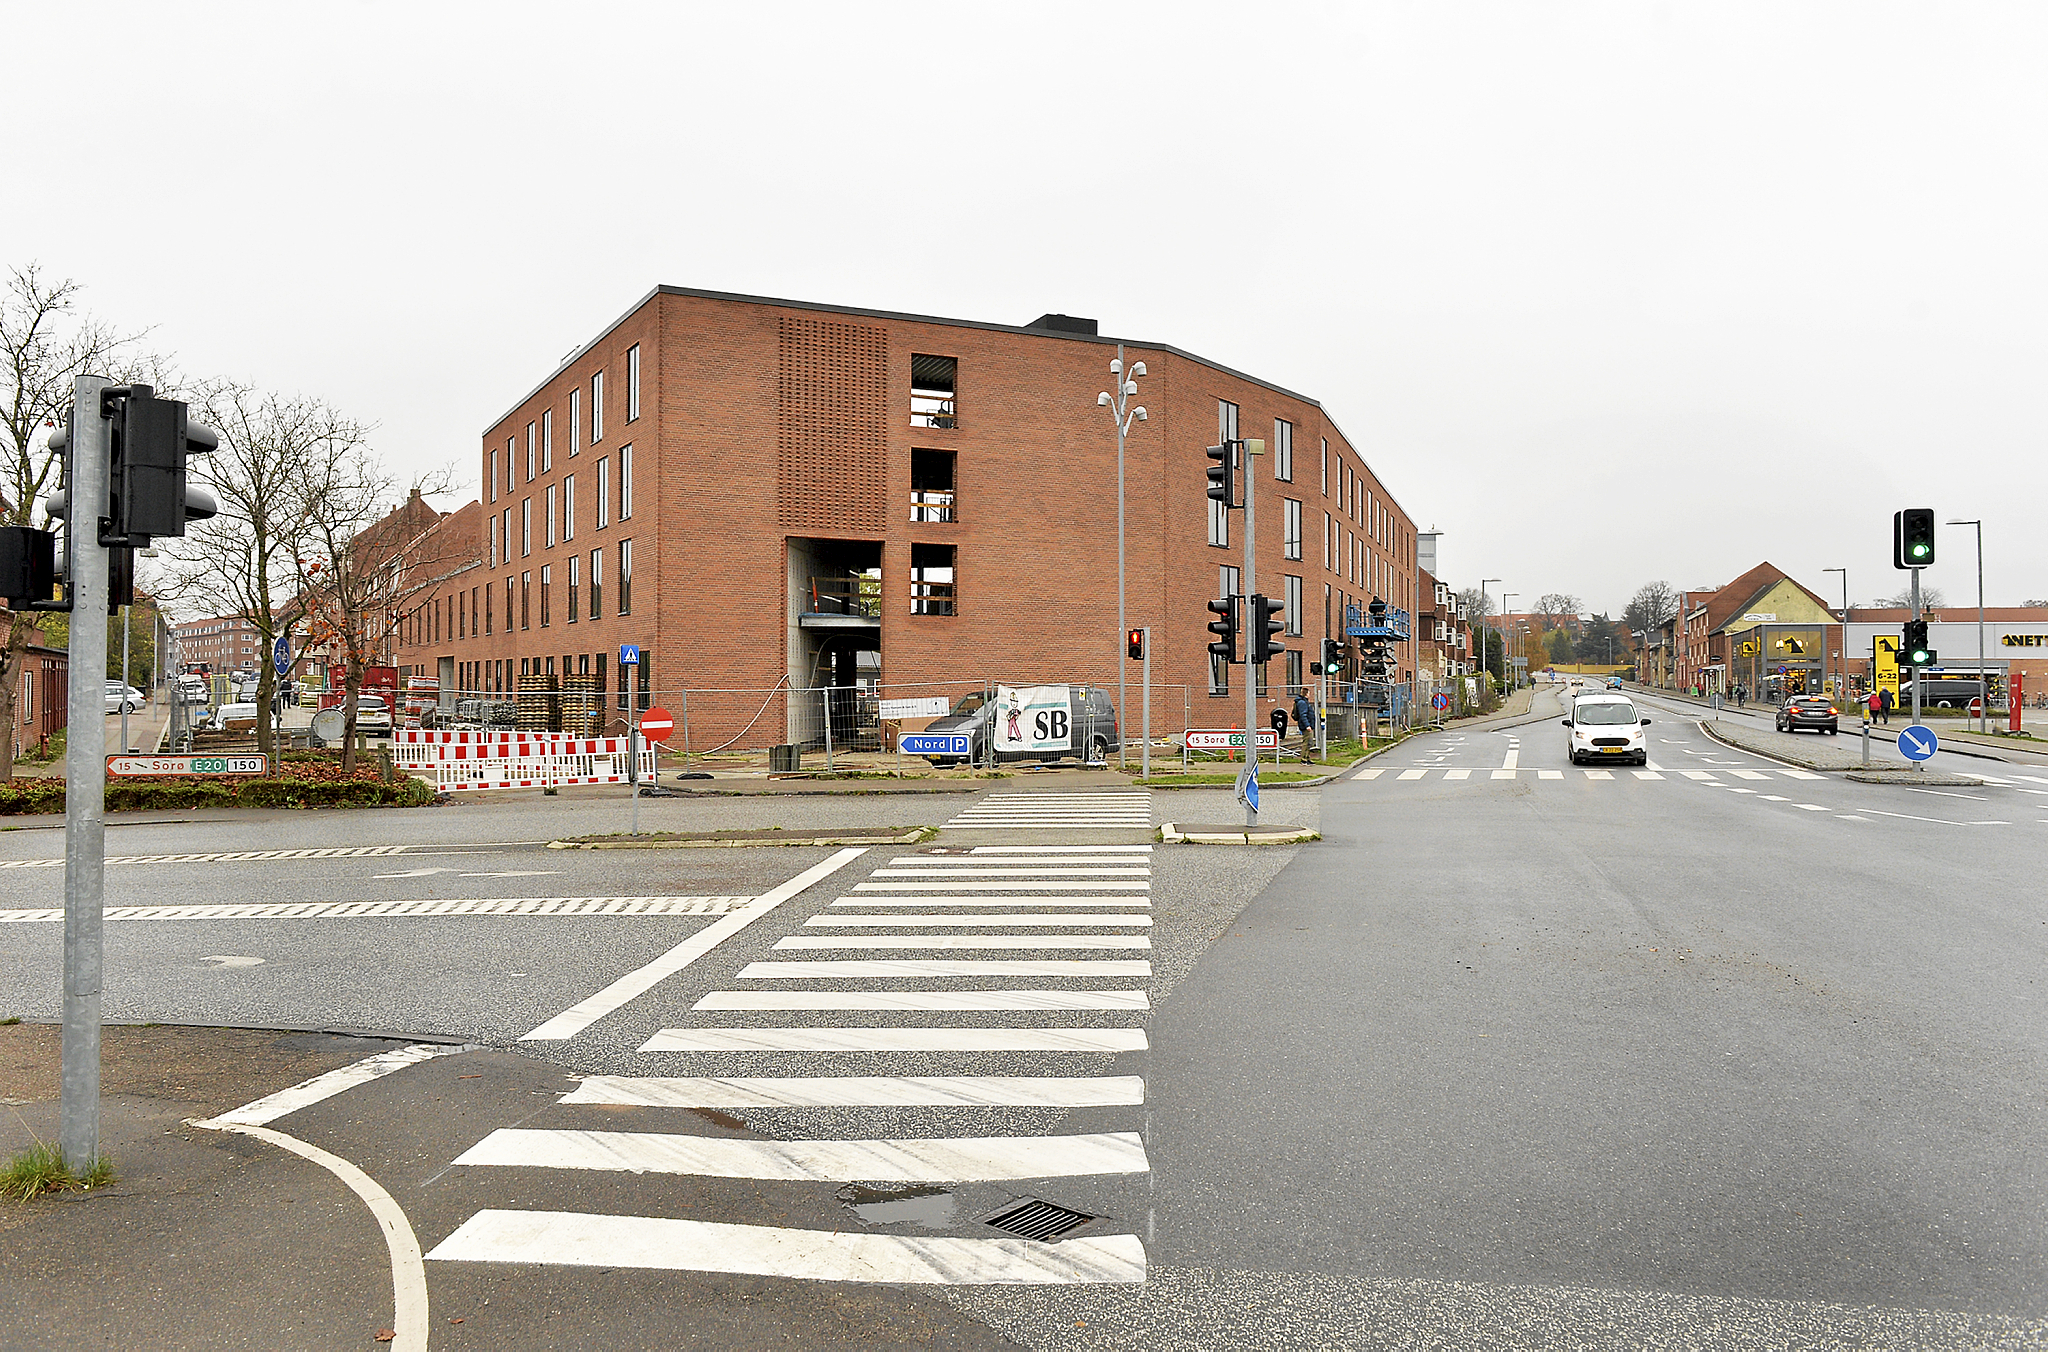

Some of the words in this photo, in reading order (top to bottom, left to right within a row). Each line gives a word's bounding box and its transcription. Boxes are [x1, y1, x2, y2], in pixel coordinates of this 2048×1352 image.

[1033, 710, 1068, 740] SB
[914, 739, 946, 749] Nord
[955, 738, 965, 751] P
[1256, 736, 1271, 744] 150
[119, 762, 131, 770] 15
[152, 760, 185, 770] Sorø
[195, 761, 222, 770] E20
[233, 760, 257, 770] 150
